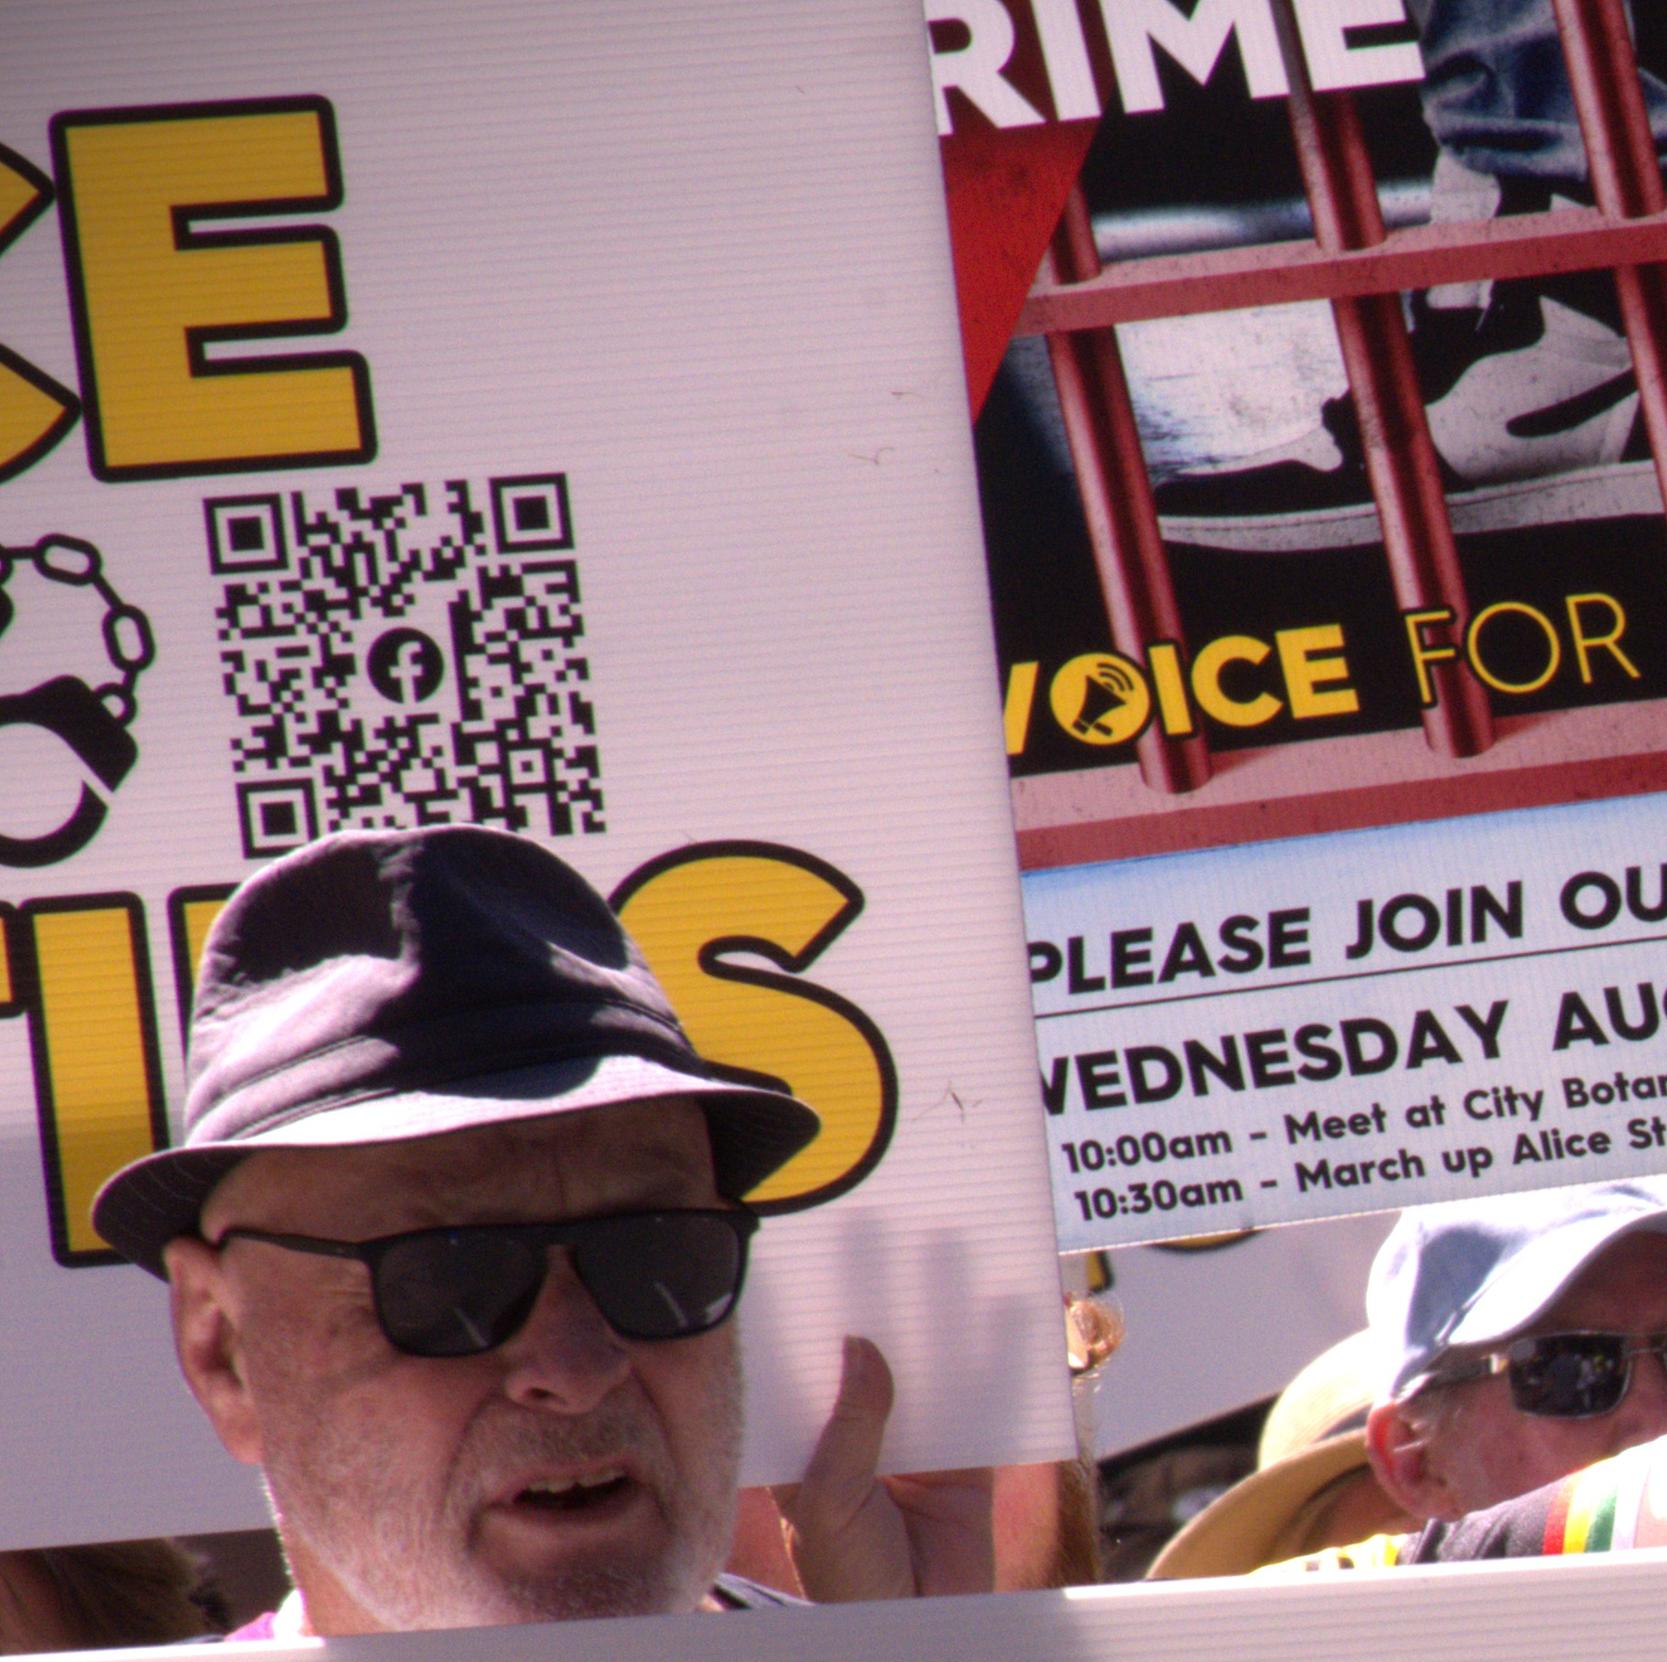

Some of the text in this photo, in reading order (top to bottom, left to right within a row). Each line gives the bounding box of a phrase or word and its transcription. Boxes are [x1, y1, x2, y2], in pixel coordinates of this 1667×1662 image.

[1404, 592, 1641, 705] FOR
[1027, 907, 1311, 995] PLEASE
[1346, 881, 1524, 959] JOIN
[1061, 1126, 1233, 1174] 10:00am
[1283, 1107, 1387, 1147] Meet
[1404, 1098, 1446, 1131] at
[1463, 1085, 1545, 1124] City
[1074, 1176, 1245, 1222] 10:30am
[1294, 1149, 1425, 1195] March
[1441, 1144, 1494, 1179] up
[1511, 1127, 1612, 1165] Alice
[1627, 1115, 1667, 1151] St
